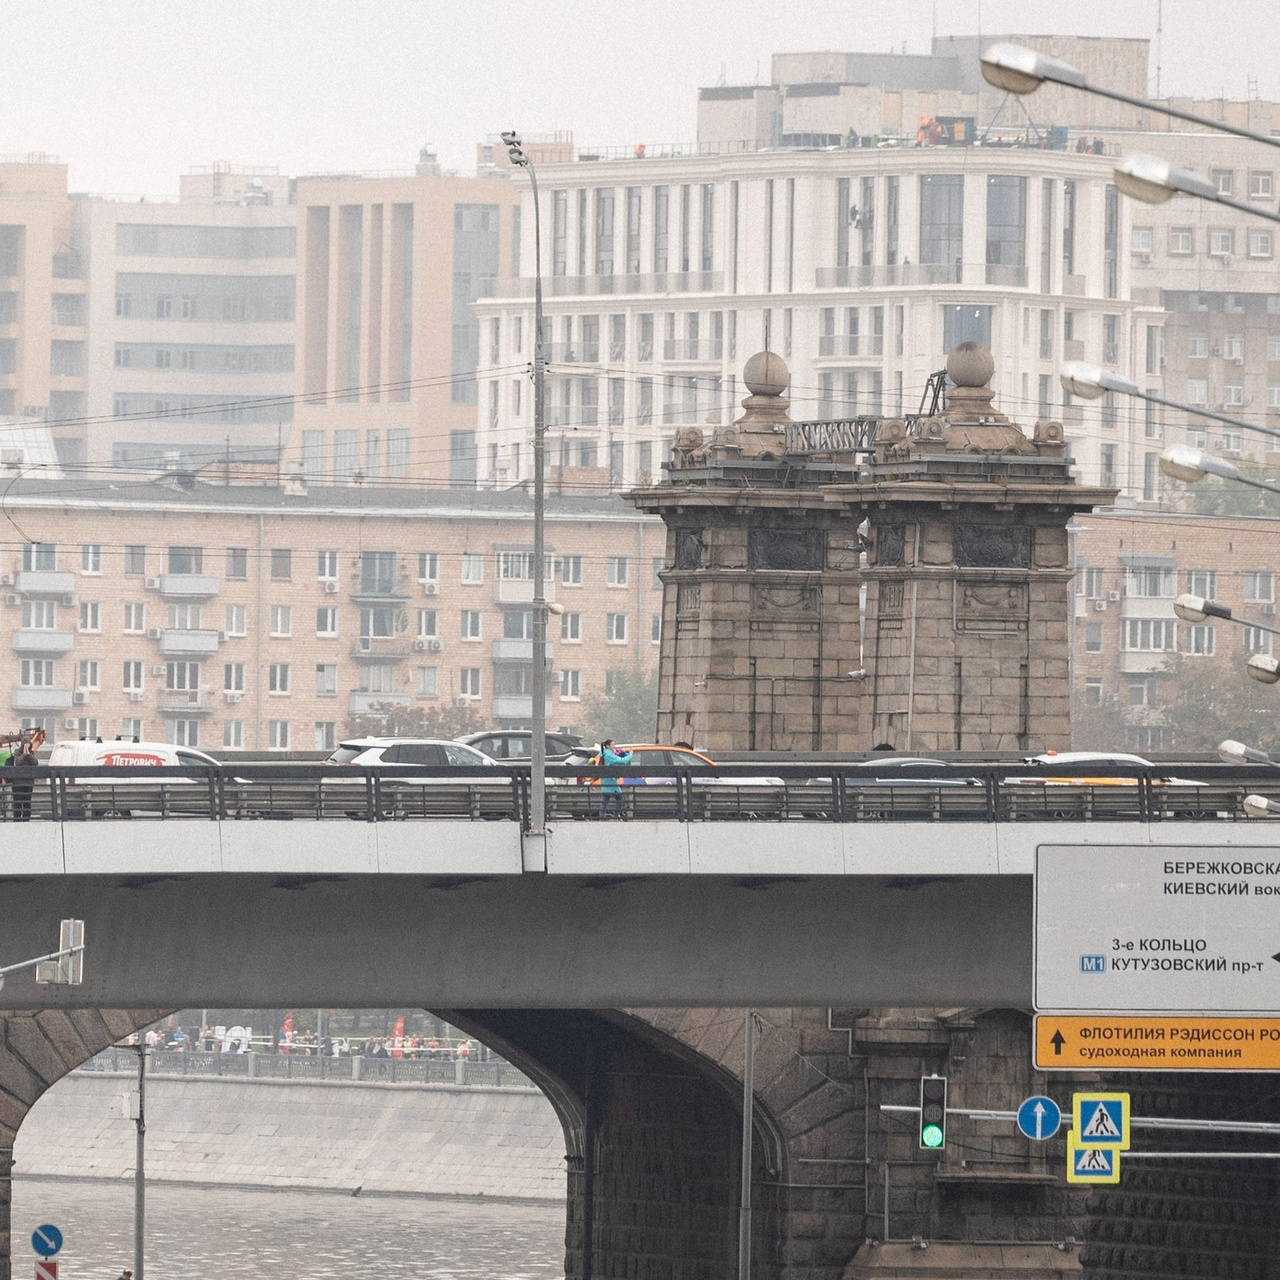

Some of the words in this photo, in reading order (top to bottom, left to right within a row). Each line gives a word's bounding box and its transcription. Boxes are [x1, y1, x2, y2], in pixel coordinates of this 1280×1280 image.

[1164, 880, 1249, 895] КИЕВСКИЙ
[1112, 939, 1135, 951] 3-е
[1139, 939, 1207, 953] КОЛЬЦО
[1111, 956, 1227, 971] КУТУЗОВСКИЙ
[1232, 962, 1264, 974] пр-т
[1079, 1027, 1165, 1040] ФЛОТИЛИЯ
[1170, 1028, 1255, 1042] РЭДИССОН
[1260, 1029, 1280, 1041] РО
[1079, 1047, 1166, 1059] судоходная
[1171, 1048, 1242, 1058] компания
